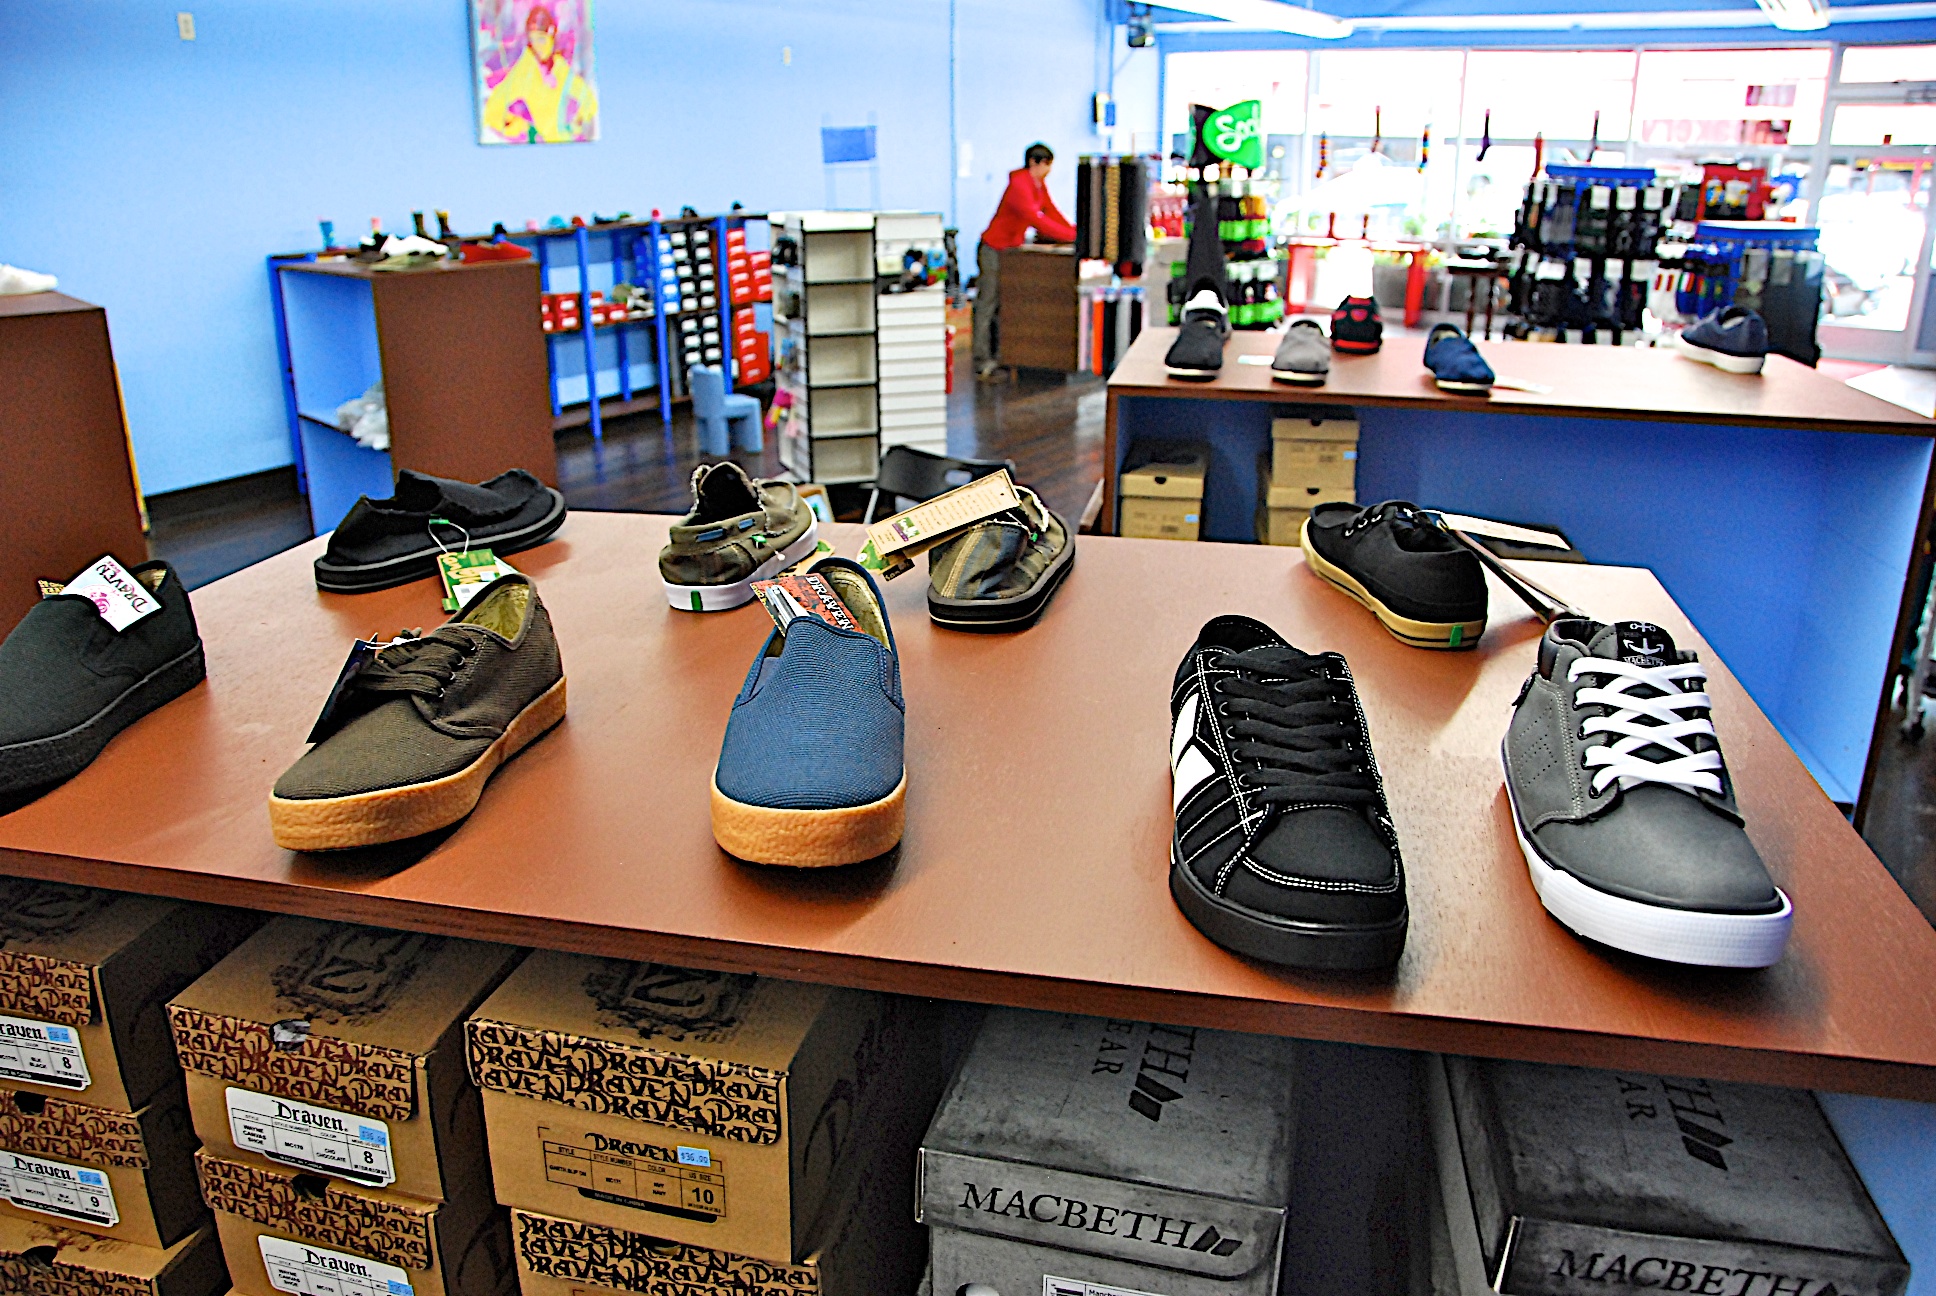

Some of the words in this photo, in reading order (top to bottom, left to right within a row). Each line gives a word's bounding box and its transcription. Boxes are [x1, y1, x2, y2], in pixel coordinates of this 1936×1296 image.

[96, 564, 148, 613] DRAVEN
[805, 575, 855, 630] DRAVEN
[62, 1056, 72, 1069] 8
[558, 1146, 575, 1156] STYLE
[585, 1133, 679, 1164] DRAVEN
[363, 1150, 374, 1164] 8
[593, 1153, 609, 1163] STYLE
[609, 1157, 633, 1167] NUMBER
[647, 1164, 666, 1173] COLOR
[699, 1174, 712, 1182] SIZE
[90, 1196, 100, 1208] 9
[691, 1187, 714, 1204] 10
[959, 1182, 1197, 1250] MACBETH
[1550, 1249, 1815, 1296] MACBETH
